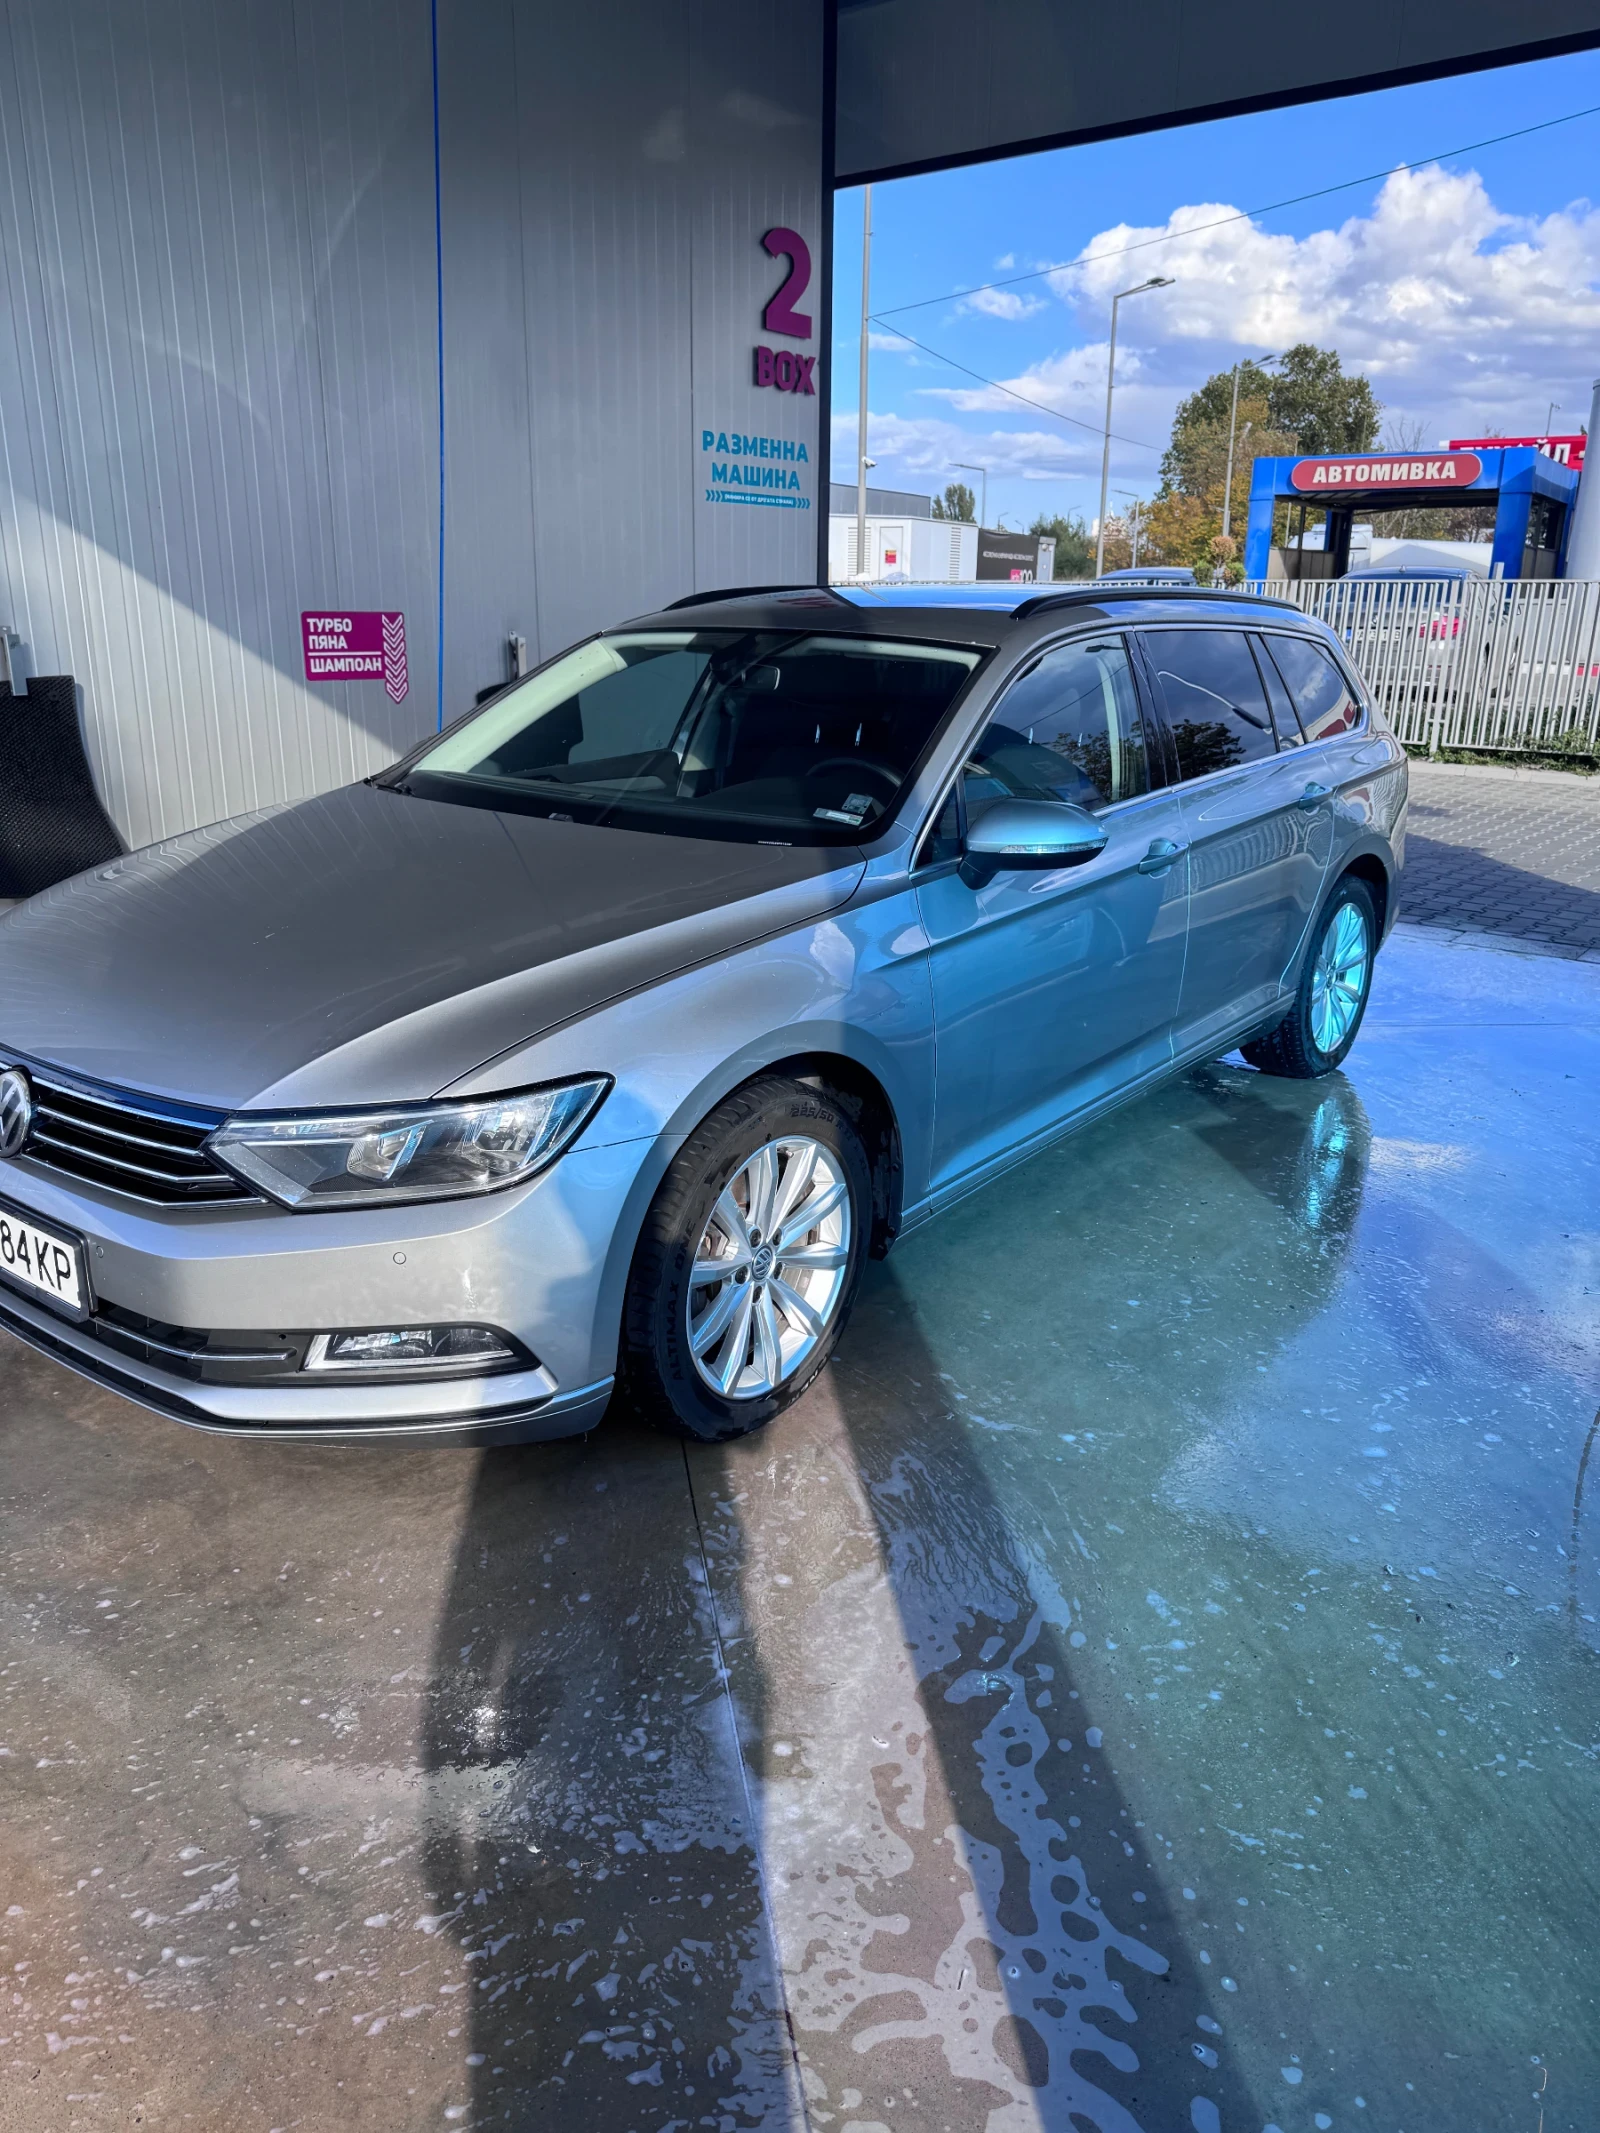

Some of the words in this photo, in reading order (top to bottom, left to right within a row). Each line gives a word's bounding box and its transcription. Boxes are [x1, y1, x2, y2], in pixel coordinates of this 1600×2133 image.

[763, 226, 813, 339] 2
[757, 345, 816, 396] BOX
[702, 430, 809, 463] РАЗМЕННА
[711, 462, 801, 490] МАШИНА
[1312, 461, 1457, 484] АВТОМИВКА
[306, 617, 353, 633] ТУРБО
[308, 635, 348, 649] ПЯНА
[309, 657, 383, 673] ШАМПОАН
